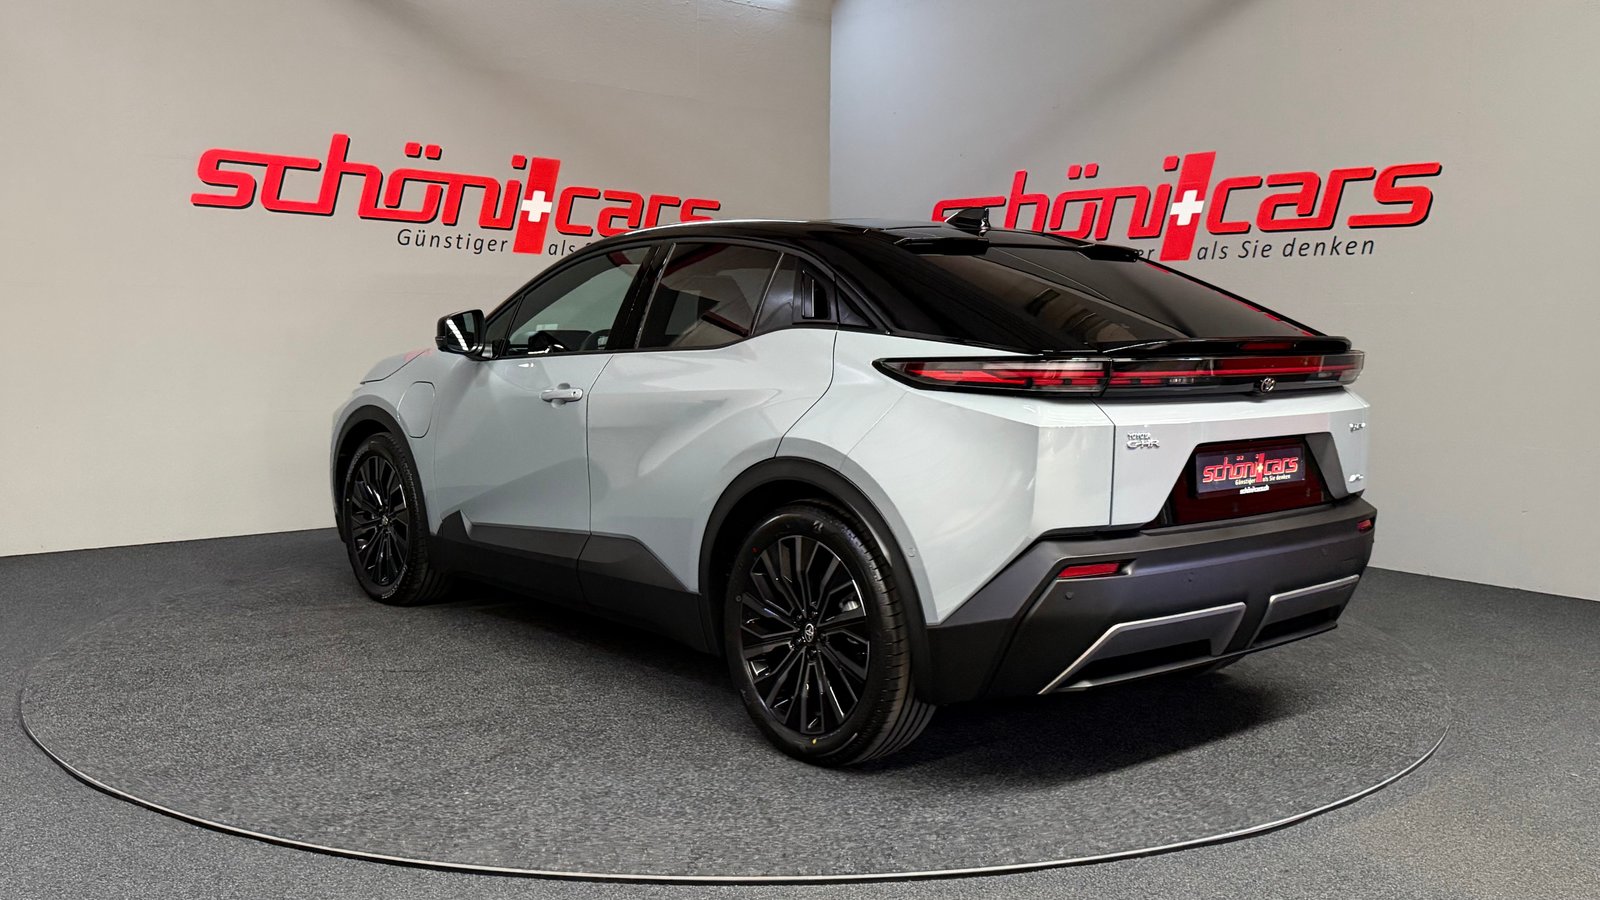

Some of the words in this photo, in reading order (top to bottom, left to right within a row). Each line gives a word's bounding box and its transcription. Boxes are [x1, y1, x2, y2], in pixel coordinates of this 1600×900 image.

[397, 229, 509, 255] Günstiger
[1197, 240, 1229, 261] als
[1238, 239, 1273, 259] Sie
[1282, 236, 1375, 258] denken
